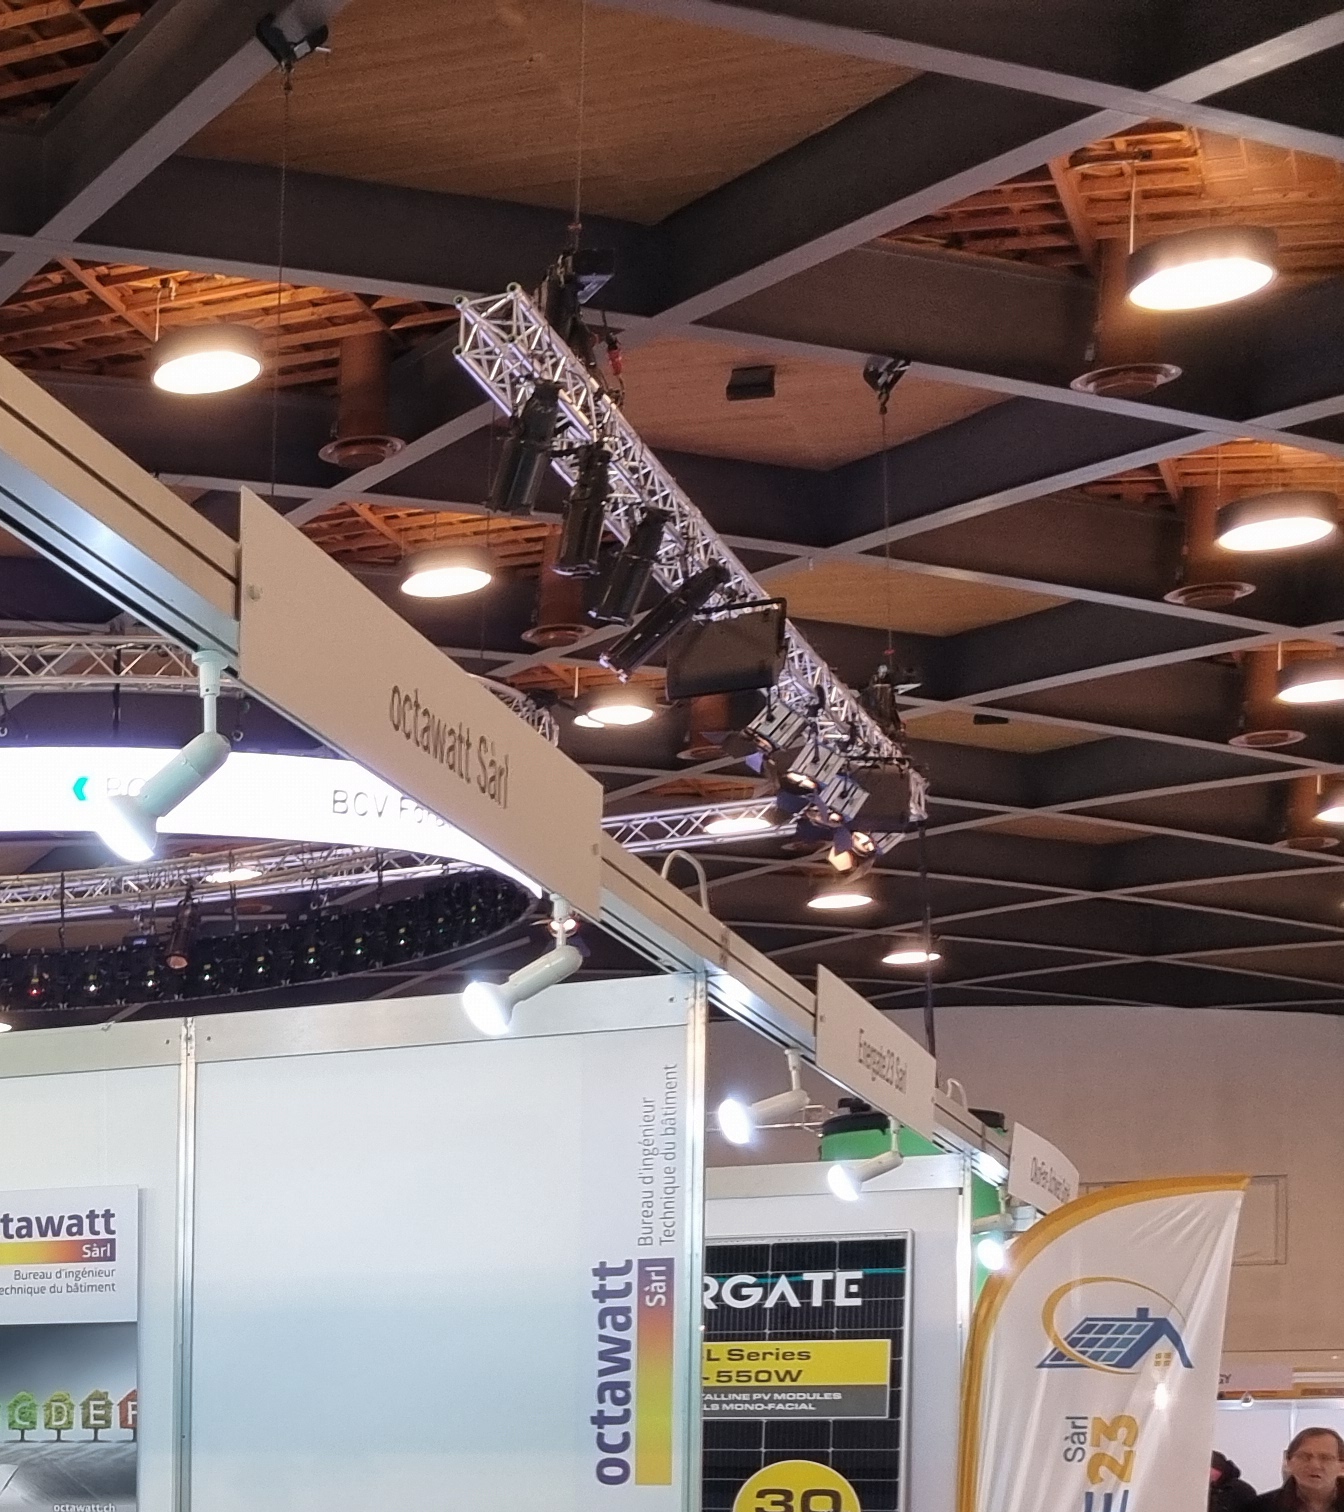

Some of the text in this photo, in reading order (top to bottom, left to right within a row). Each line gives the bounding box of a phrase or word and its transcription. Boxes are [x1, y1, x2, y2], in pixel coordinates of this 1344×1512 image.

[389, 685, 510, 810] octawatt Sàrl
[332, 789, 389, 818] BCV
[659, 1063, 678, 1245] Technique du bâtiment
[637, 1096, 659, 1247] Bureau d'ingénieur
[81, 1243, 111, 1259] Sàrl
[13, 1266, 116, 1283] Bureau d'ingénieur
[48, 1282, 63, 1295] du
[65, 1281, 117, 1295] bâtiment
[645, 1265, 667, 1308] Sàrl
[703, 1270, 863, 1309] RGATE
[727, 1348, 812, 1362] Series
[590, 1258, 634, 1487] octawatt
[715, 1369, 803, 1384] 550W
[702, 1392, 843, 1401] ALLINE PV MODULES
[702, 1402, 817, 1411] LS MONO-FACIAL
[13, 1400, 32, 1427] C
[48, 1401, 68, 1426] D
[87, 1400, 107, 1425] E
[1064, 1414, 1088, 1463] Sàrl
